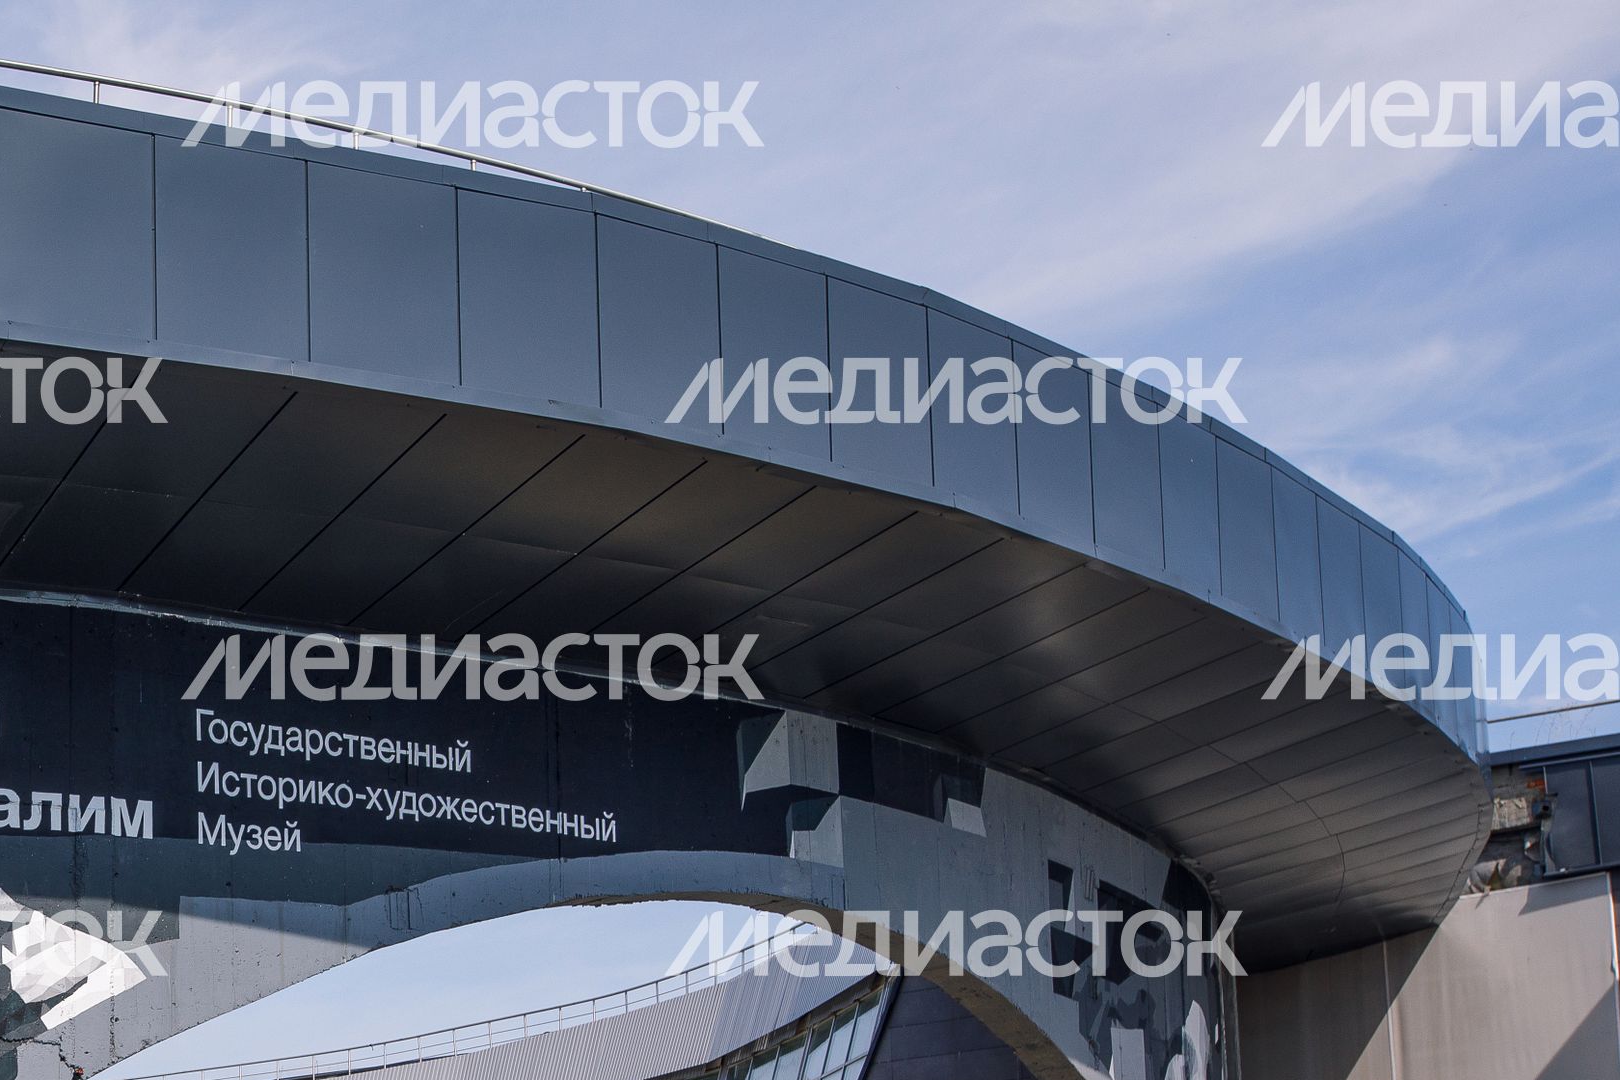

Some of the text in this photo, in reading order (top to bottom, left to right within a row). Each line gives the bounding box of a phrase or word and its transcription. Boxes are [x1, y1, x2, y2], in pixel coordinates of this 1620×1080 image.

[195, 708, 472, 773] Государственный
[196, 761, 617, 843] Историко-художественный
[197, 811, 301, 855] Музей
